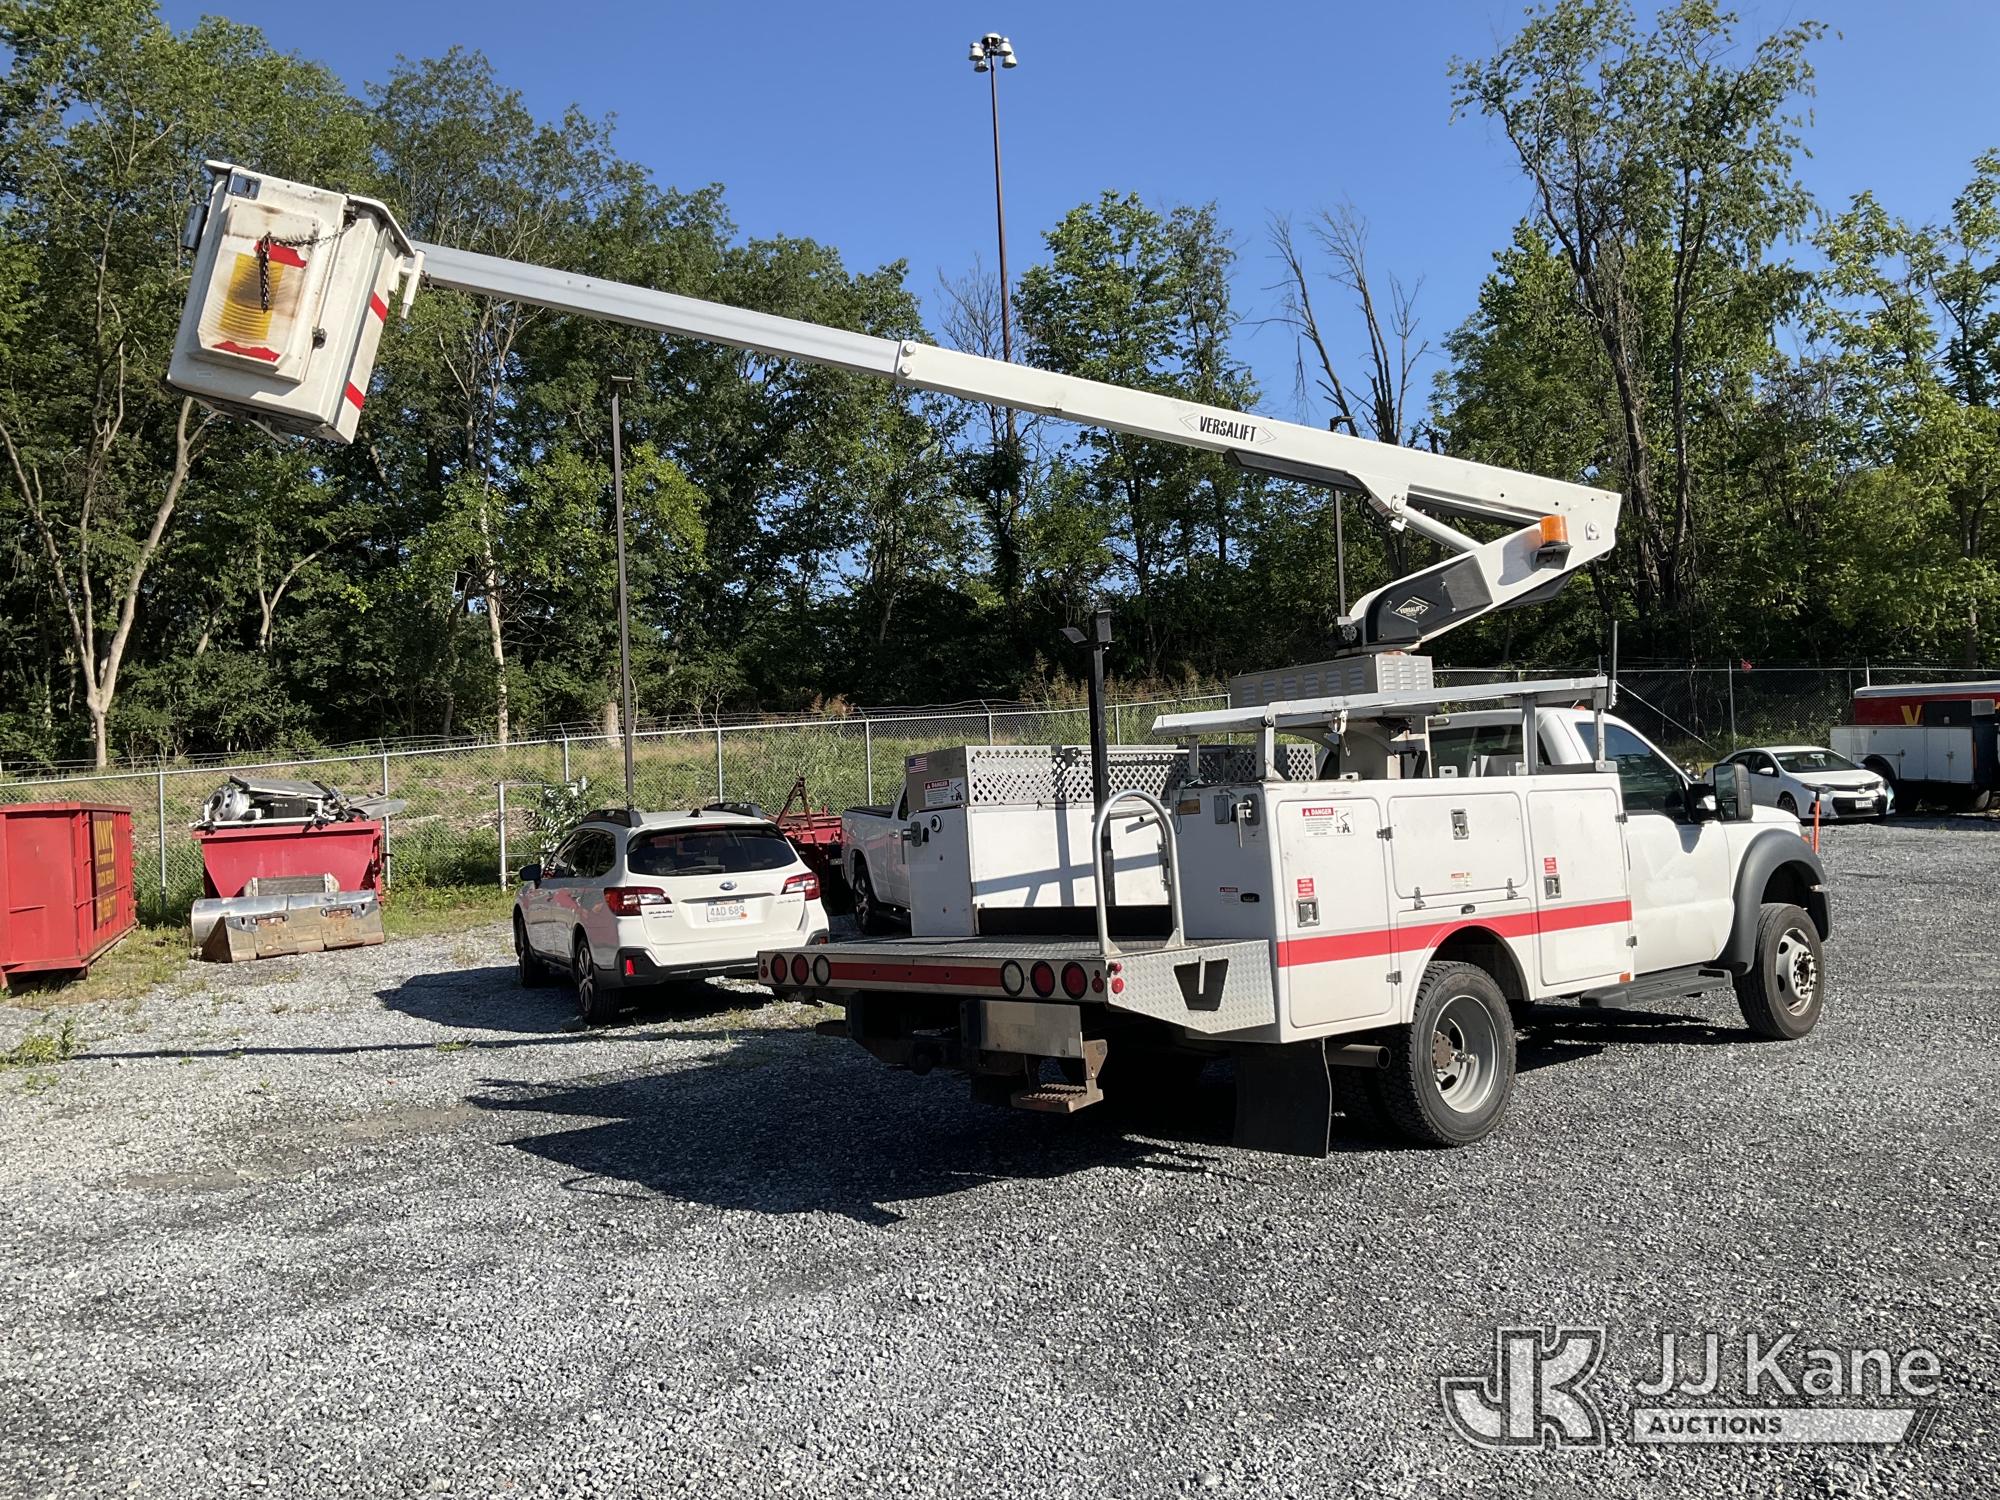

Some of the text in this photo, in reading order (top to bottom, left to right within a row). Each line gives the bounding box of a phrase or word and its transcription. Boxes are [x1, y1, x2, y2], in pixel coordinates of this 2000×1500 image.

[1199, 415, 1257, 442] VERSALIFT
[931, 780, 949, 788] DANGER
[1310, 808, 1333, 816] DANGER
